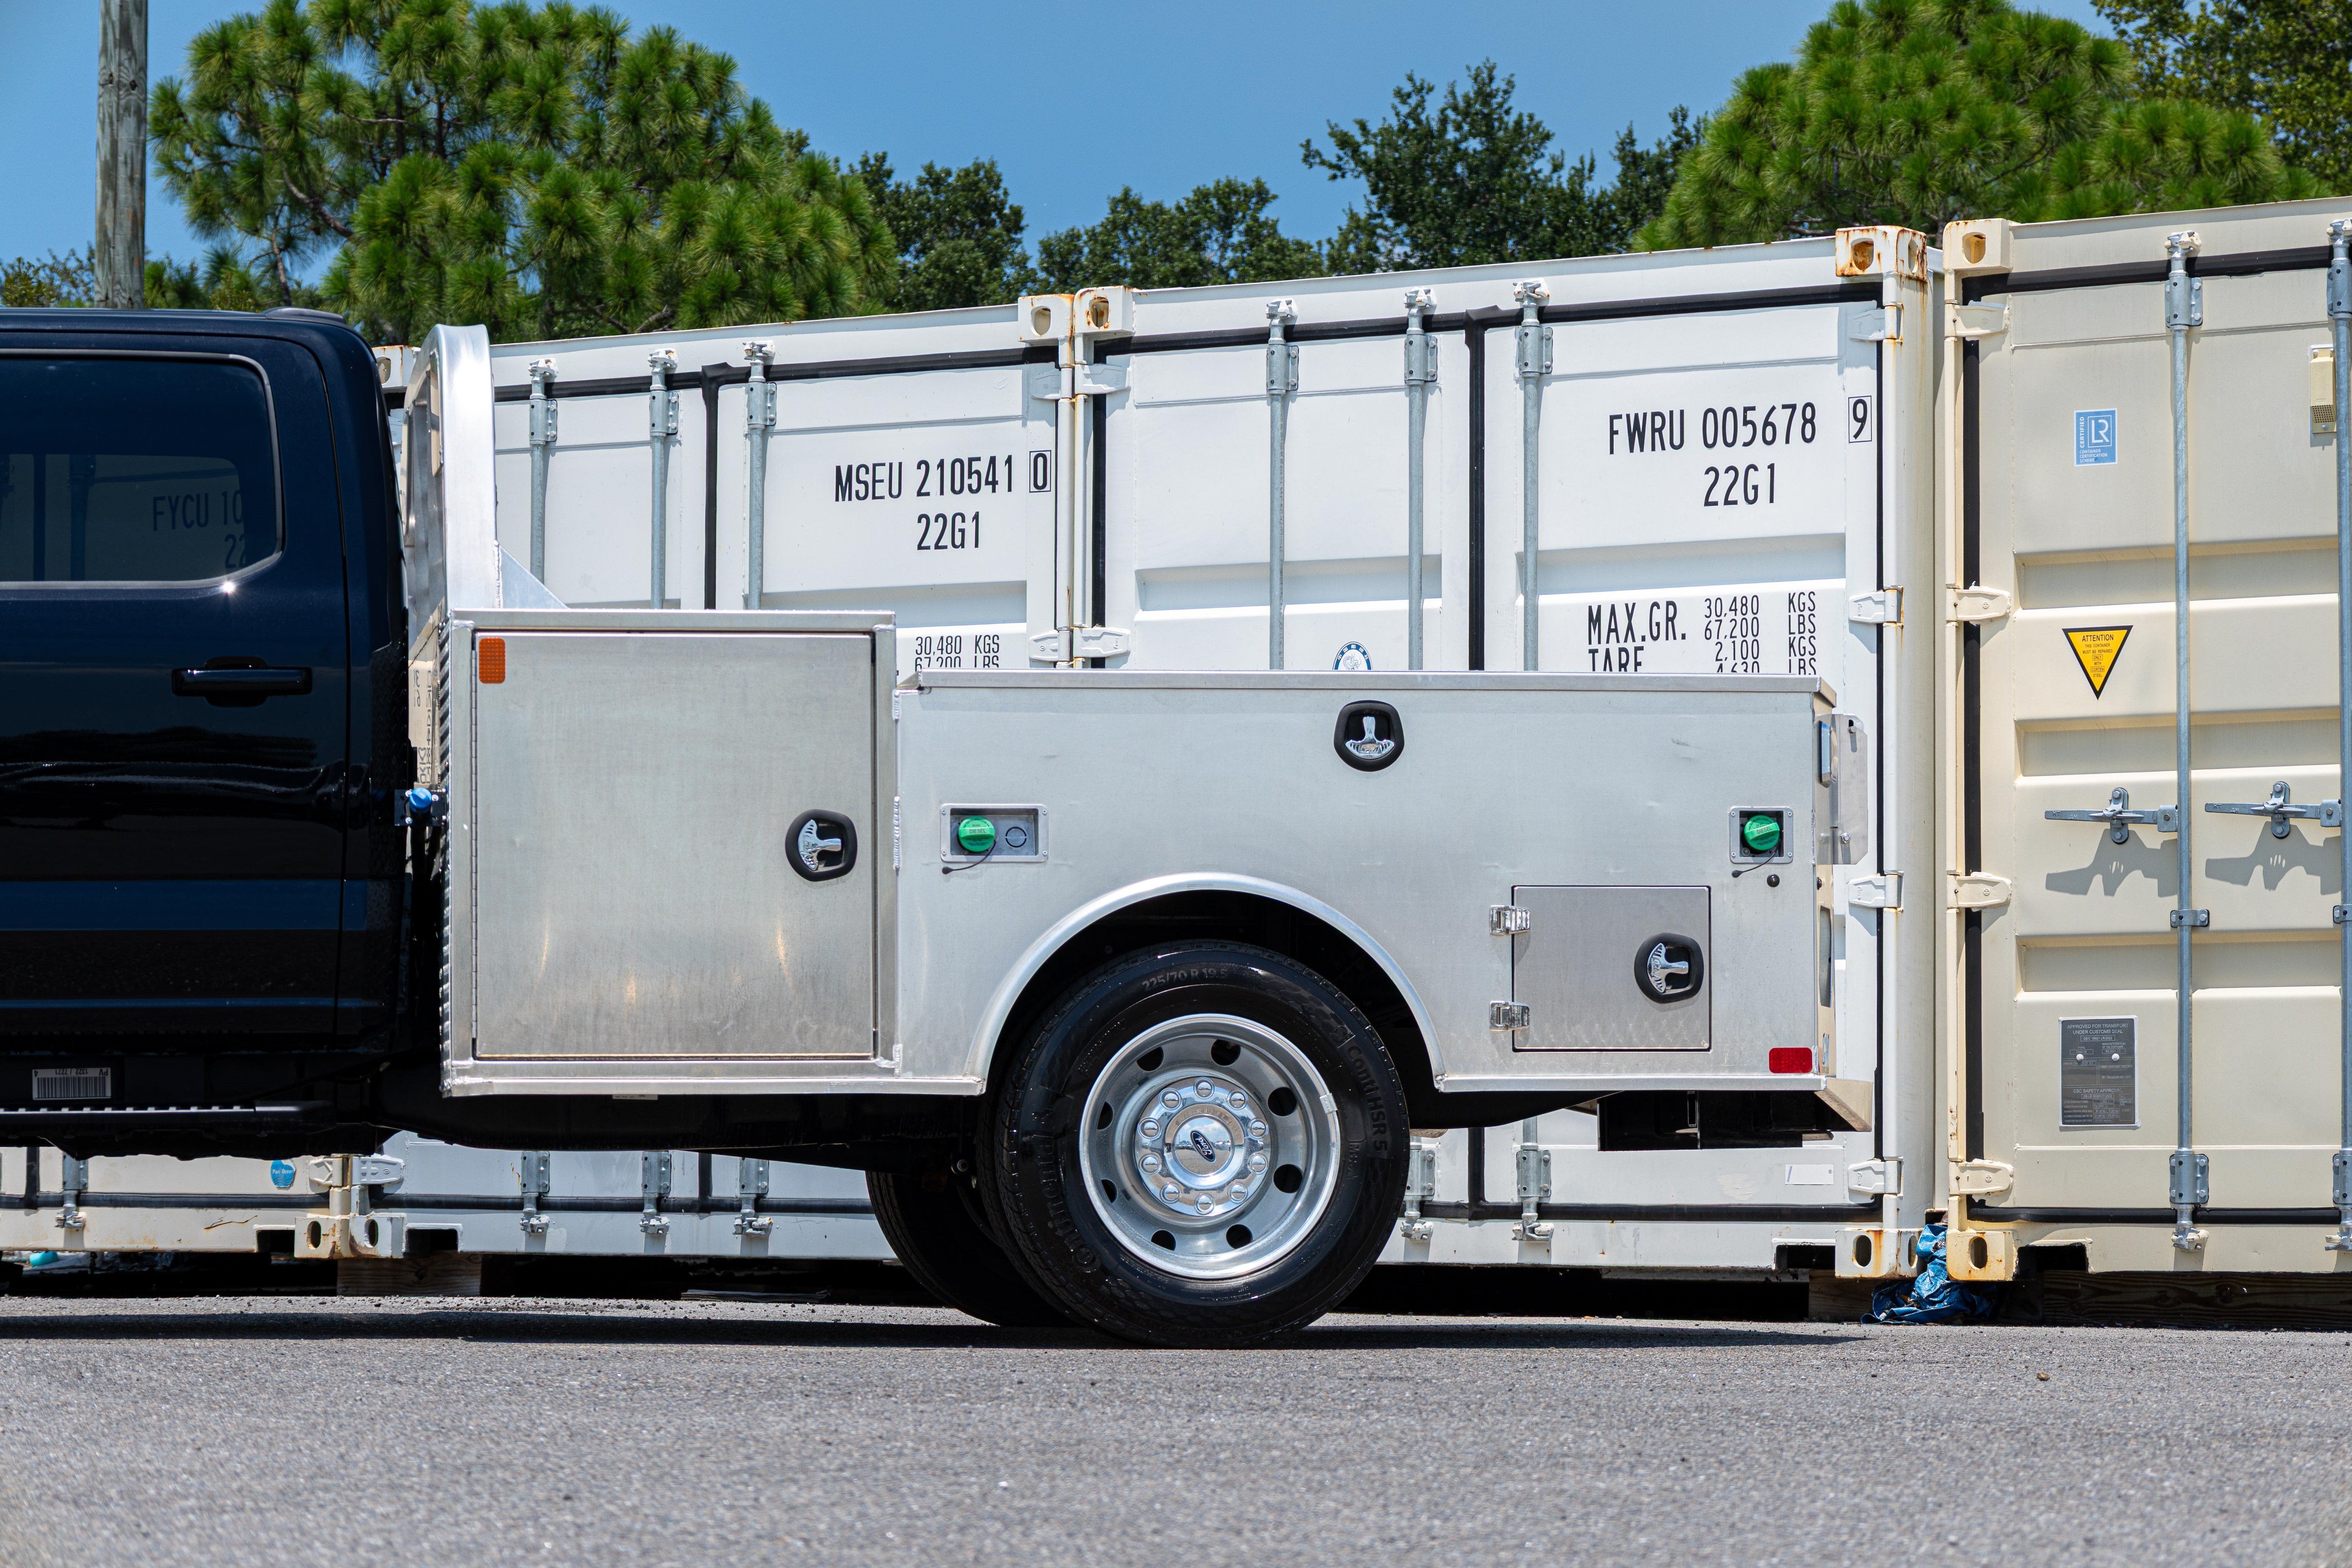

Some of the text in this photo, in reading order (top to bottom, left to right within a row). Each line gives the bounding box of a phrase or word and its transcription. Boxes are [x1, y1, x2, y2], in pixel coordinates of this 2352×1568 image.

[1609, 399, 1868, 455] FWRU 005678 9
[2091, 419, 2109, 443] LR
[835, 452, 1048, 502] MSEU 210541 0
[1704, 463, 1775, 507] 22G1
[152, 492, 209, 531] FYCU
[917, 511, 980, 550] 22G1
[1588, 590, 1816, 645] MAX.GR. 30,480 KGS
[1704, 613, 1816, 640] 67,200 LBS
[915, 634, 1000, 655] 30,480 KGS
[1715, 639, 1760, 662] 2,100
[1788, 635, 1817, 657] KGS
[2082, 634, 2114, 642] ATTENTION
[1756, 826, 1773, 834] DIESEL
[1142, 967, 1228, 992] 225/70 R 19.5
[1347, 1046, 1388, 1152] Conti HSR 5
[1195, 1136, 1212, 1155] Ford
